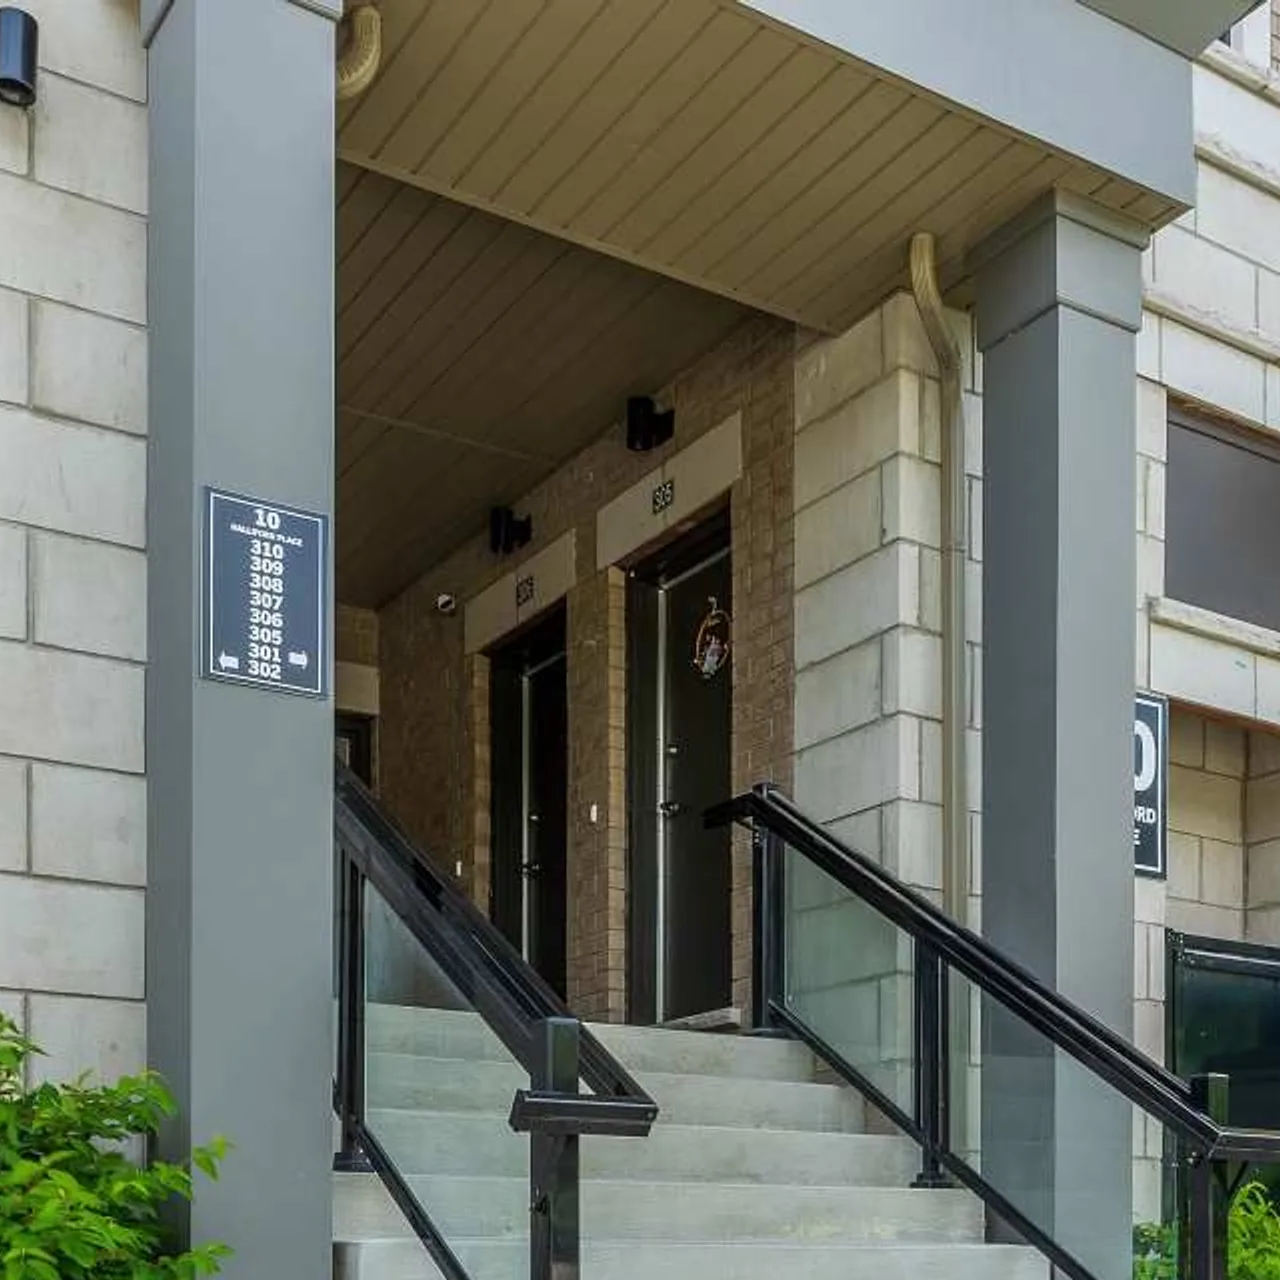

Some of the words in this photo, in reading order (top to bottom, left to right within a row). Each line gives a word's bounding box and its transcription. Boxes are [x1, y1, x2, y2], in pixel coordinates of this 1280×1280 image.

[254, 509, 281, 529] 10
[250, 539, 283, 559] 310
[250, 556, 283, 575] 309
[249, 573, 283, 593] 308
[250, 591, 283, 610] 307
[250, 608, 283, 627] 306
[249, 626, 282, 645] 305
[248, 643, 281, 663] 301
[248, 660, 281, 679] 302
